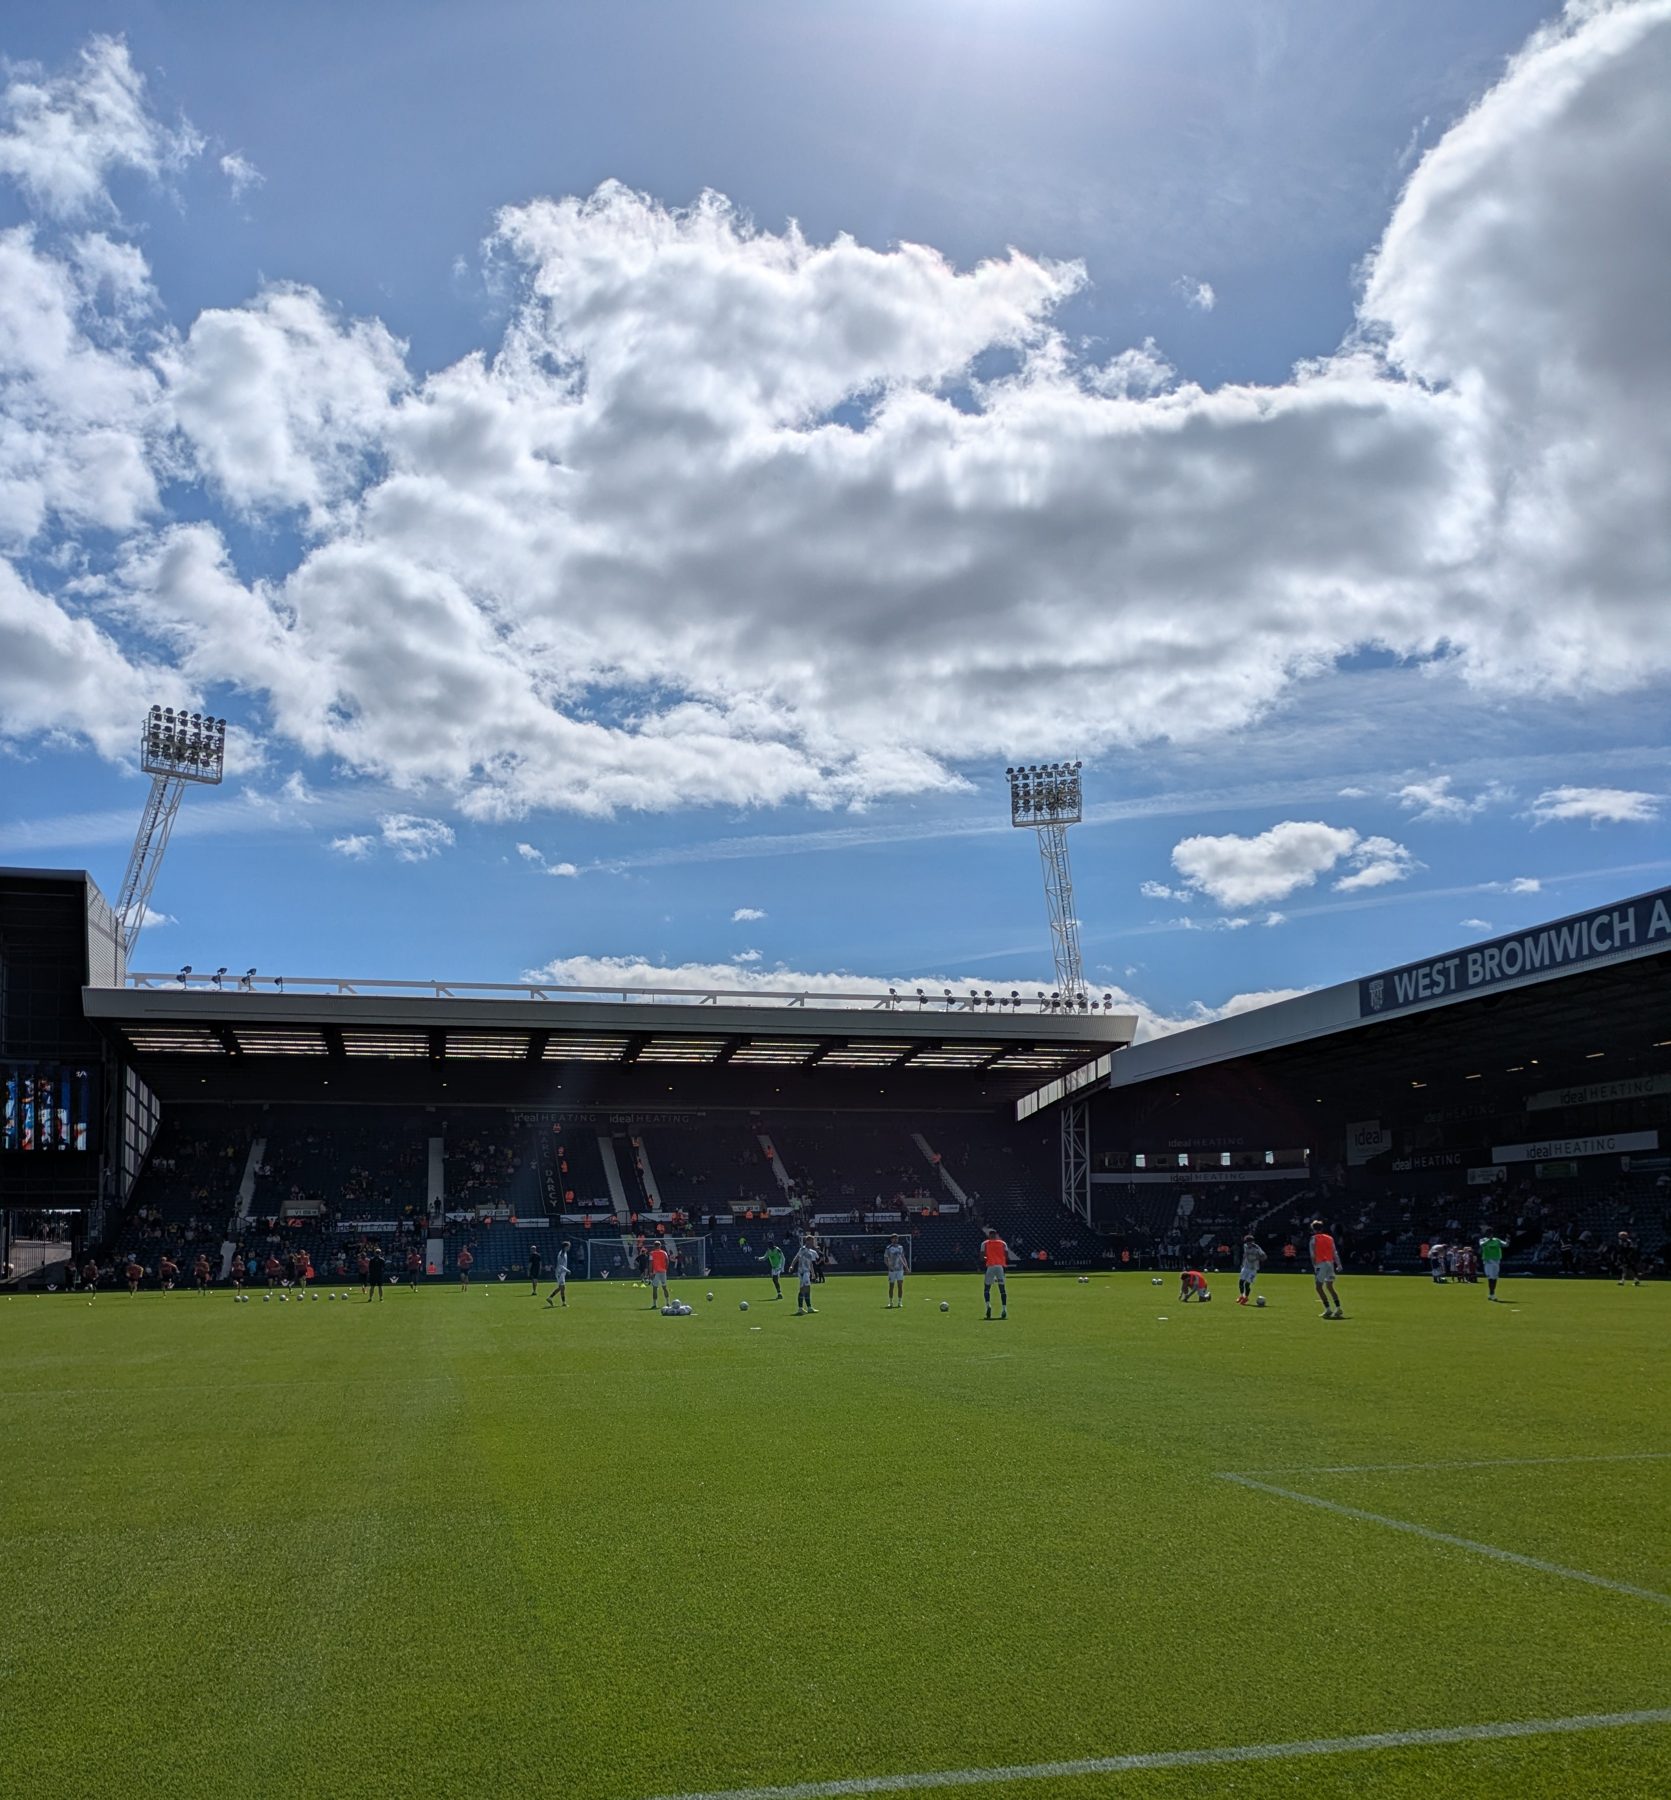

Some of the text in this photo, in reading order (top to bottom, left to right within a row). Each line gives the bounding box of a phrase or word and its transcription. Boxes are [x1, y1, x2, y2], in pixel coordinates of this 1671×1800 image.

[1393, 957, 1460, 1004] WEST
[1467, 907, 1636, 984] BROMWICH
[1560, 1080, 1654, 1104] ideal HEATING
[514, 1112, 597, 1122] ideal HEATING
[609, 1113, 689, 1123] ideal HEATING
[1354, 1127, 1383, 1146] ideal
[1525, 1138, 1616, 1159] ideal HEATING
[1414, 1153, 1462, 1168] HEATING
[545, 1169, 561, 1208] DARCY
